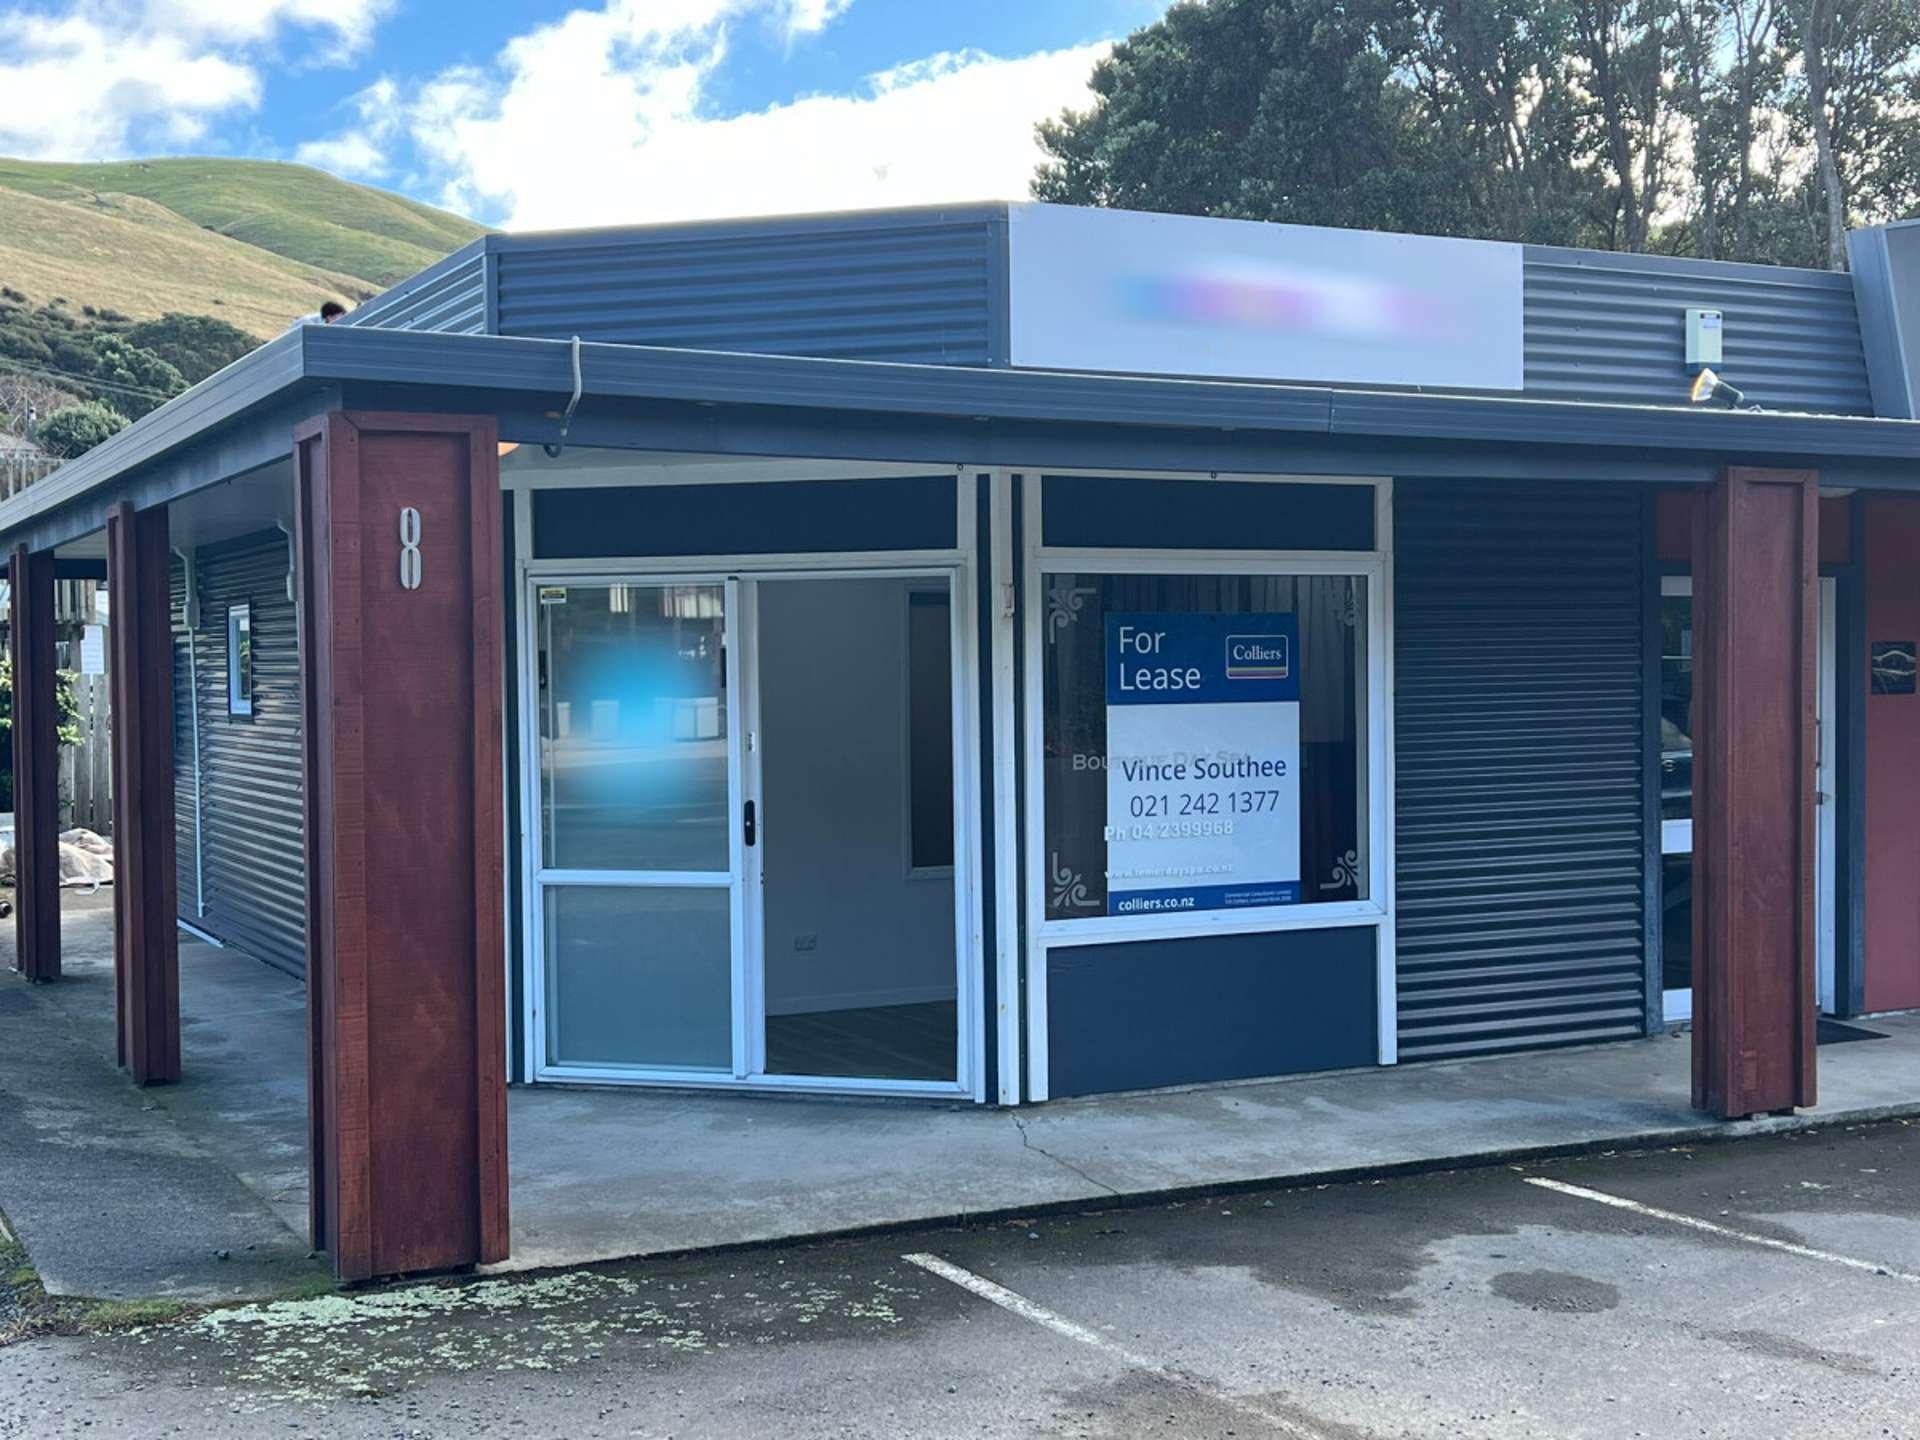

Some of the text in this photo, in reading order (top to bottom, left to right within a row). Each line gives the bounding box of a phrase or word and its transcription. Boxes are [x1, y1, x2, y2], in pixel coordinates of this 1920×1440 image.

[400, 506, 422, 590] 8
[1118, 626, 1166, 655] For
[1232, 644, 1282, 661] Colliers
[1118, 663, 1201, 691] Lease
[1122, 757, 1287, 783] Vince Southee
[1130, 790, 1280, 818] 021 242 1377
[1104, 820, 1234, 841] Ph 04 2399968
[1118, 896, 1195, 912] colliers.co.nz
